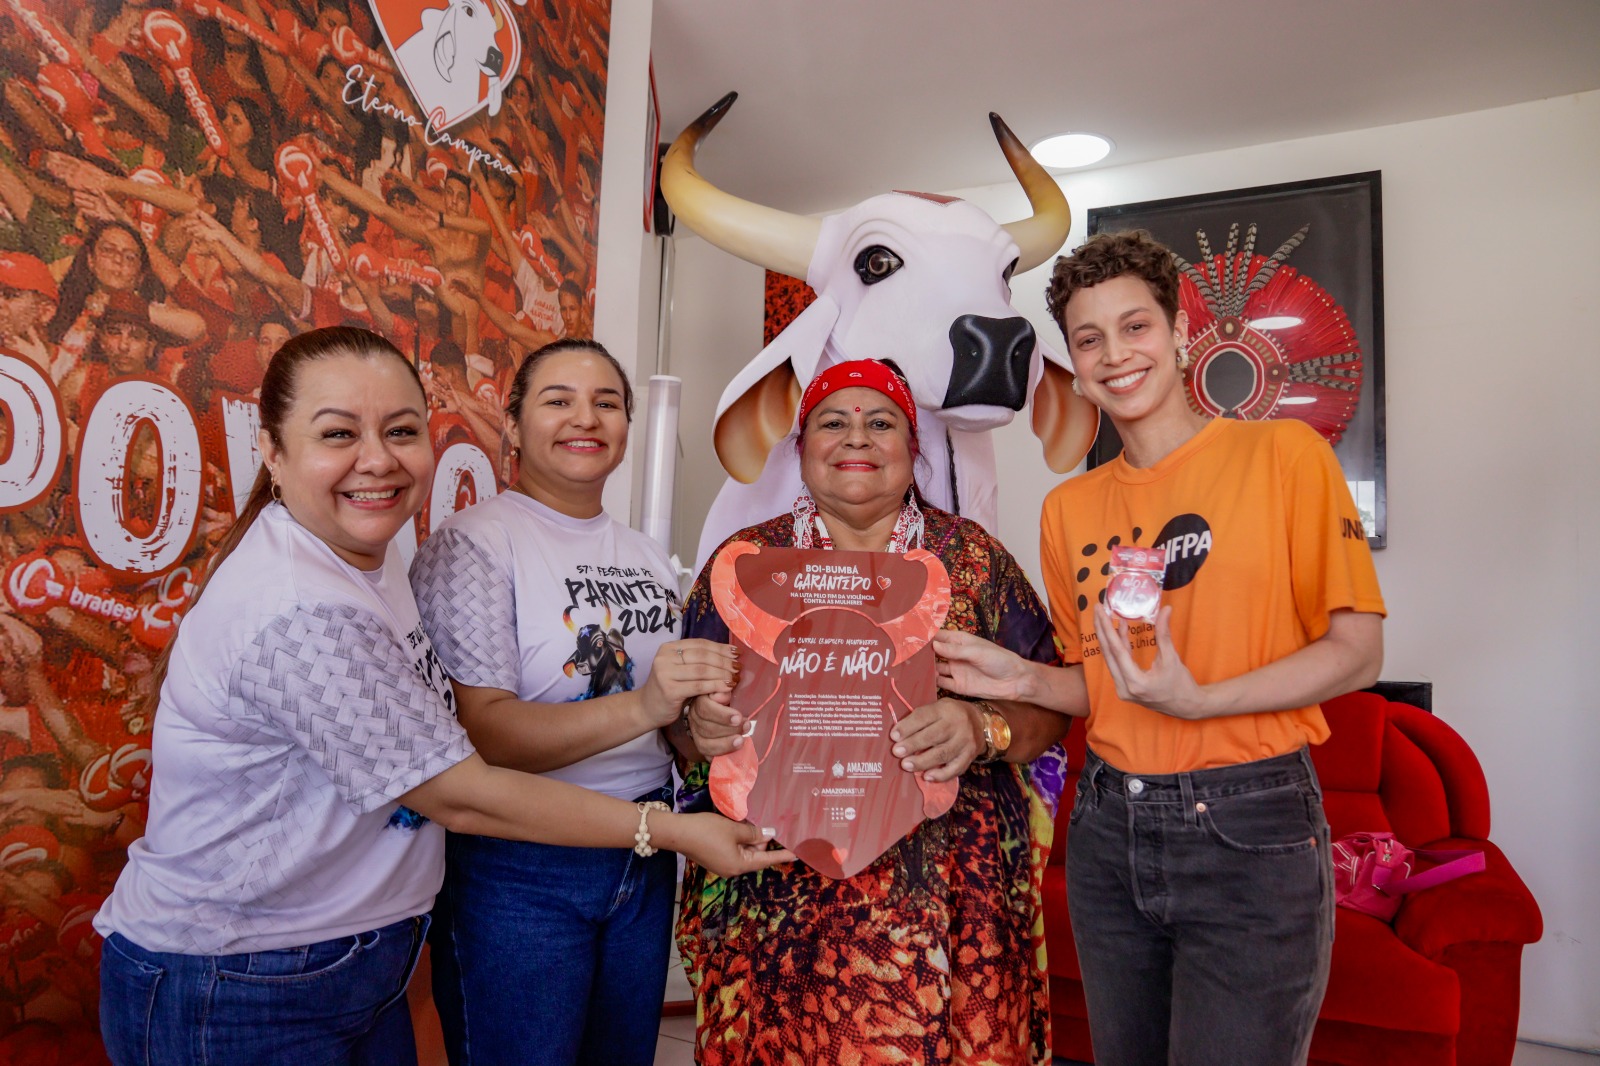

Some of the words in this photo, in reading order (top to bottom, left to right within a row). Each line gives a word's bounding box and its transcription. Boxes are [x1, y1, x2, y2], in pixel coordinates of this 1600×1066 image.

[174, 66, 222, 149] bradesco
[342, 64, 422, 126] Eterno
[424, 106, 518, 174] Campeão
[304, 193, 341, 263] bradesco
[1157, 530, 1212, 564] NFPA
[597, 566, 640, 578] FESTIVAL
[806, 565, 859, 574] BOI-BUMBÁ
[70, 586, 139, 621] brades
[565, 578, 676, 609] PARINTI
[618, 605, 677, 637] 2024
[1080, 632, 1098, 643] Fun
[1083, 646, 1101, 658] das
[1136, 637, 1157, 649] Unid
[779, 648, 820, 679] NÃO
[824, 652, 837, 671] É
[841, 647, 890, 681] NÃO!
[847, 762, 882, 773] AMAZONAS
